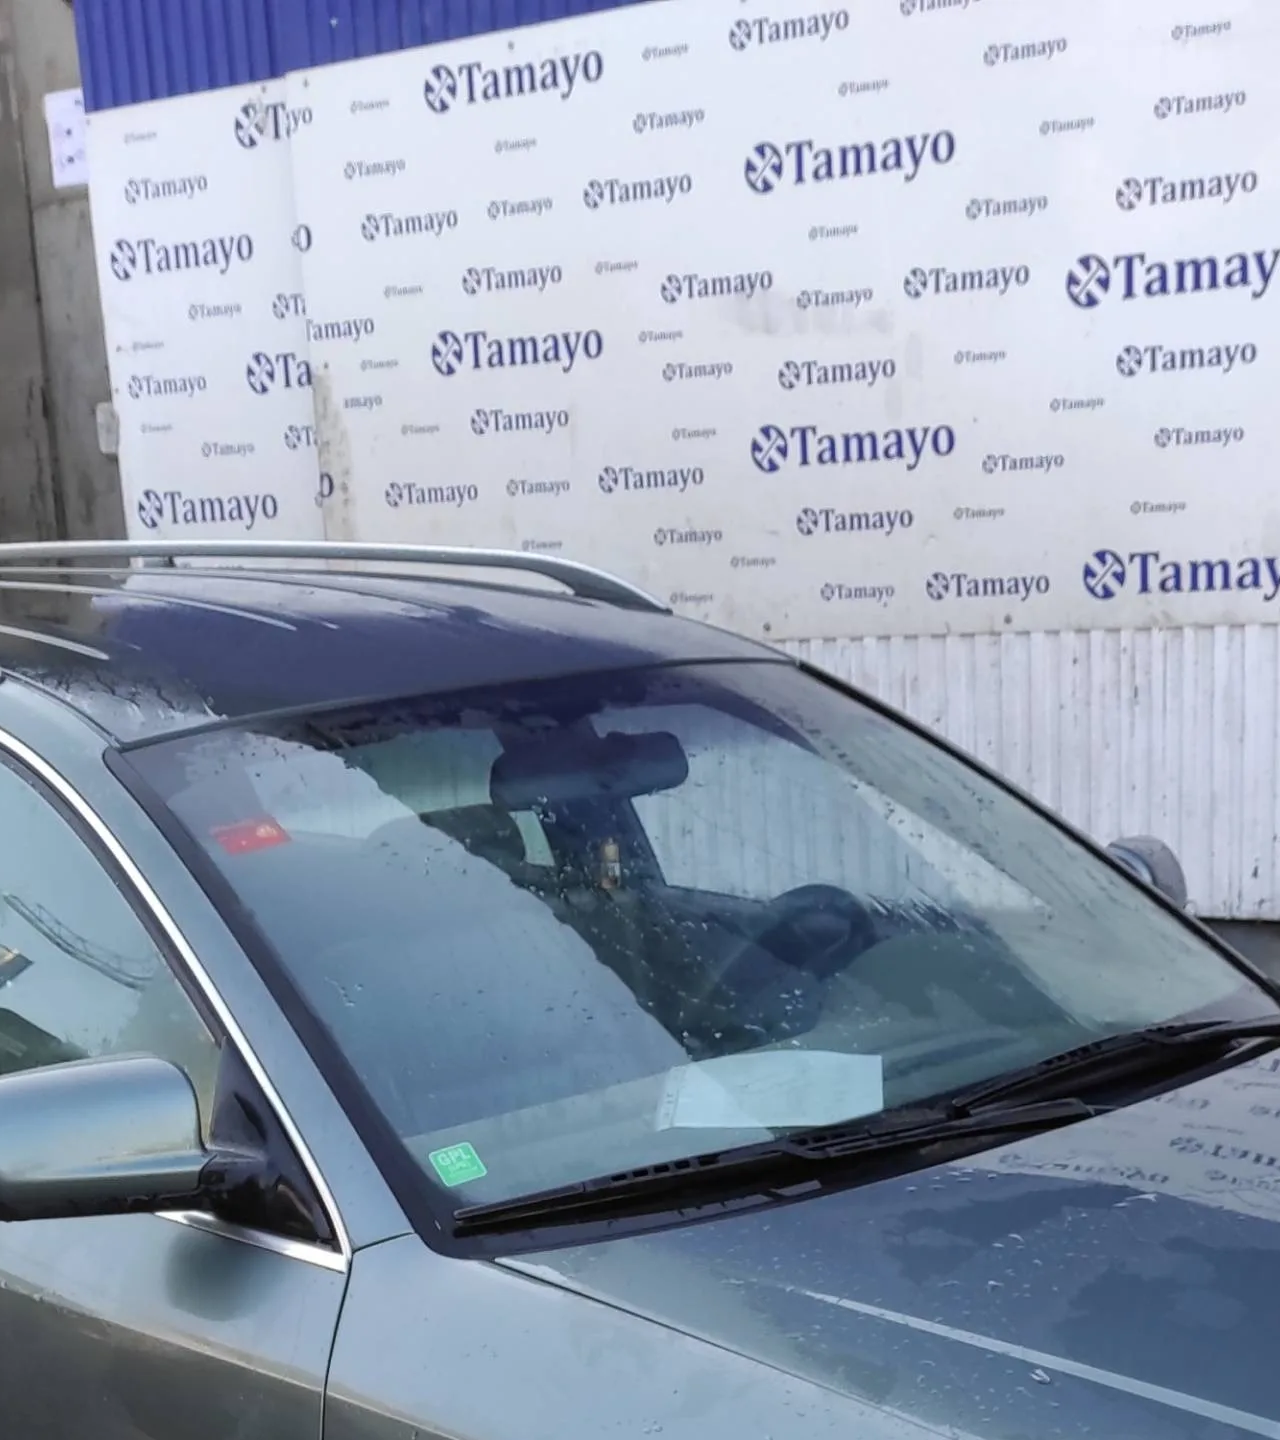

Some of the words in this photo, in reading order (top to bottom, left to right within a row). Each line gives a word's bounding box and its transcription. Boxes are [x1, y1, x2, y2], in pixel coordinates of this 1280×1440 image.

[751, 10, 849, 44] Tamayo
[999, 38, 1067, 62] Tamayo
[458, 50, 603, 104] Tamayo
[1171, 91, 1246, 115] Tamayo
[648, 109, 704, 130] Tamayo
[786, 131, 955, 184] Tamayo
[140, 176, 207, 200] Tamayo
[604, 175, 691, 204] Tamayo
[1144, 171, 1257, 205] Tamayo
[501, 197, 552, 216] Tamayo
[981, 196, 1048, 217] Tamayo
[379, 211, 458, 237] Tamayo
[137, 235, 253, 274] Tamayo
[480, 266, 562, 291] Tamayo
[683, 271, 772, 300] Tamayo
[929, 265, 1029, 295] Tamayo
[809, 289, 873, 307] Tamayo
[464, 330, 603, 373] Tamayo
[1142, 344, 1257, 373] Tamayo
[676, 362, 733, 379] Tamayo
[802, 359, 895, 386] Tamayo
[144, 376, 206, 397] Tamayo
[490, 410, 569, 434] Tamayo
[790, 426, 955, 471] Tamayo
[1171, 428, 1244, 447] Tamayo
[999, 455, 1064, 472] Tamayo
[518, 480, 570, 496] Tamayo
[619, 468, 704, 492] Tamayo
[401, 483, 478, 507] Tamayo
[164, 492, 278, 530] Tamayo
[819, 509, 913, 536] Tamayo
[667, 529, 722, 545] Tamayo
[836, 584, 895, 601] Tamayo
[950, 574, 1050, 601] Tamayo
[437, 1147, 471, 1166] GPL
